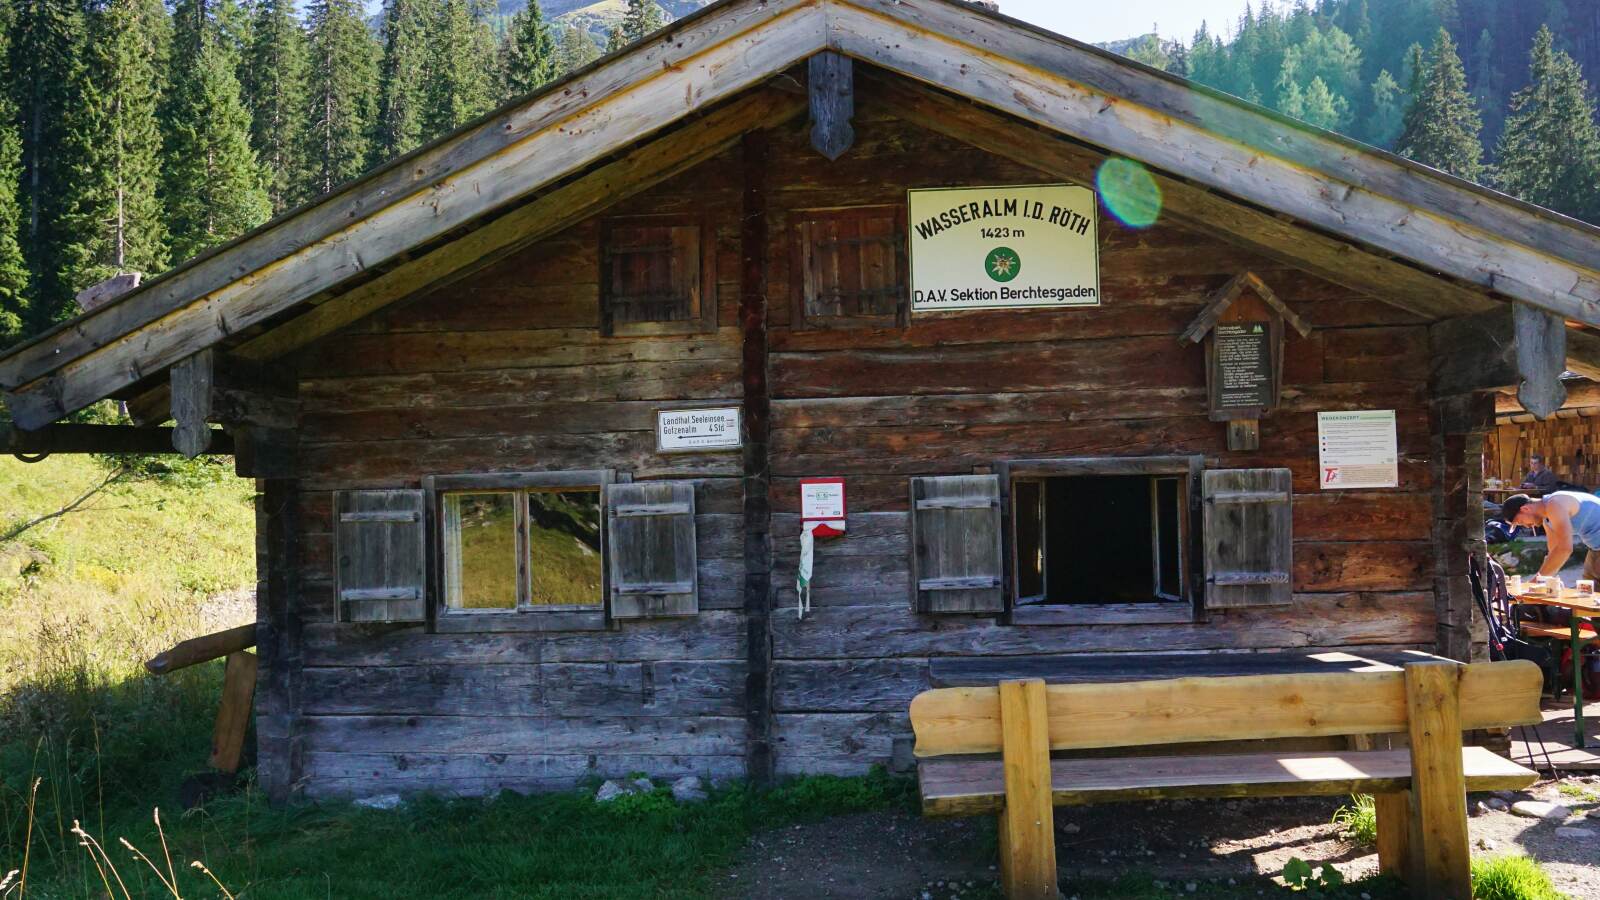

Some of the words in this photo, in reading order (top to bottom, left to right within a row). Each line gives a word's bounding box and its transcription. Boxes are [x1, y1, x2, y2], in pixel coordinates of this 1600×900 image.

[914, 198, 1018, 240] WASSERALM
[1023, 199, 1044, 221] I.D.
[1049, 206, 1091, 236] RÖTH
[980, 227, 1010, 239] 1423
[1012, 229, 1025, 238] m
[914, 289, 948, 303] D.A.V.
[950, 287, 998, 301] Sektion
[1000, 284, 1096, 301] Berchtesgaden
[708, 424, 713, 432] 4
